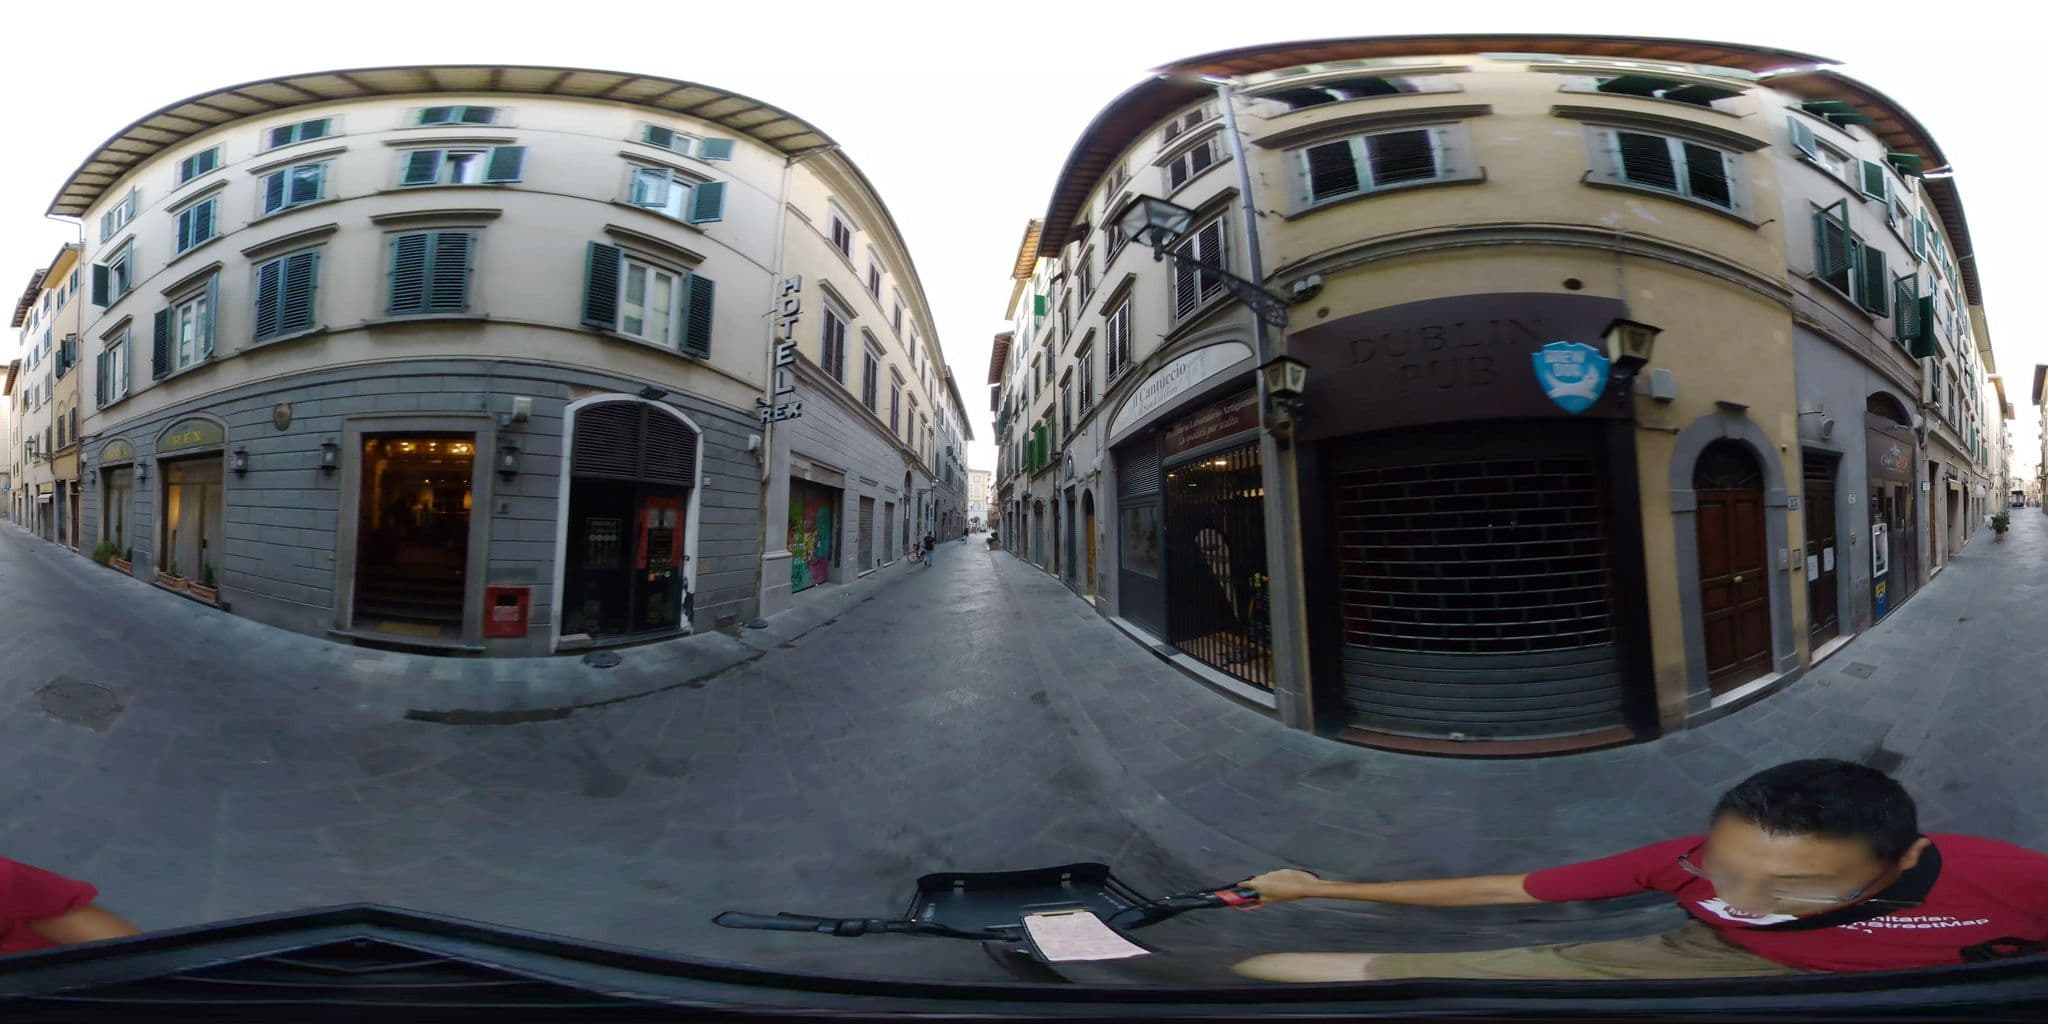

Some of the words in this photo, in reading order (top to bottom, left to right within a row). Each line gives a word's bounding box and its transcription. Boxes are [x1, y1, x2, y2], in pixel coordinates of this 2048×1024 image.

[776, 274, 802, 397] HOTEL
[1351, 318, 1543, 366] DUBLIN
[1138, 360, 1187, 402] Cantuccio
[1398, 356, 1498, 396] PUB
[761, 401, 803, 425] REX
